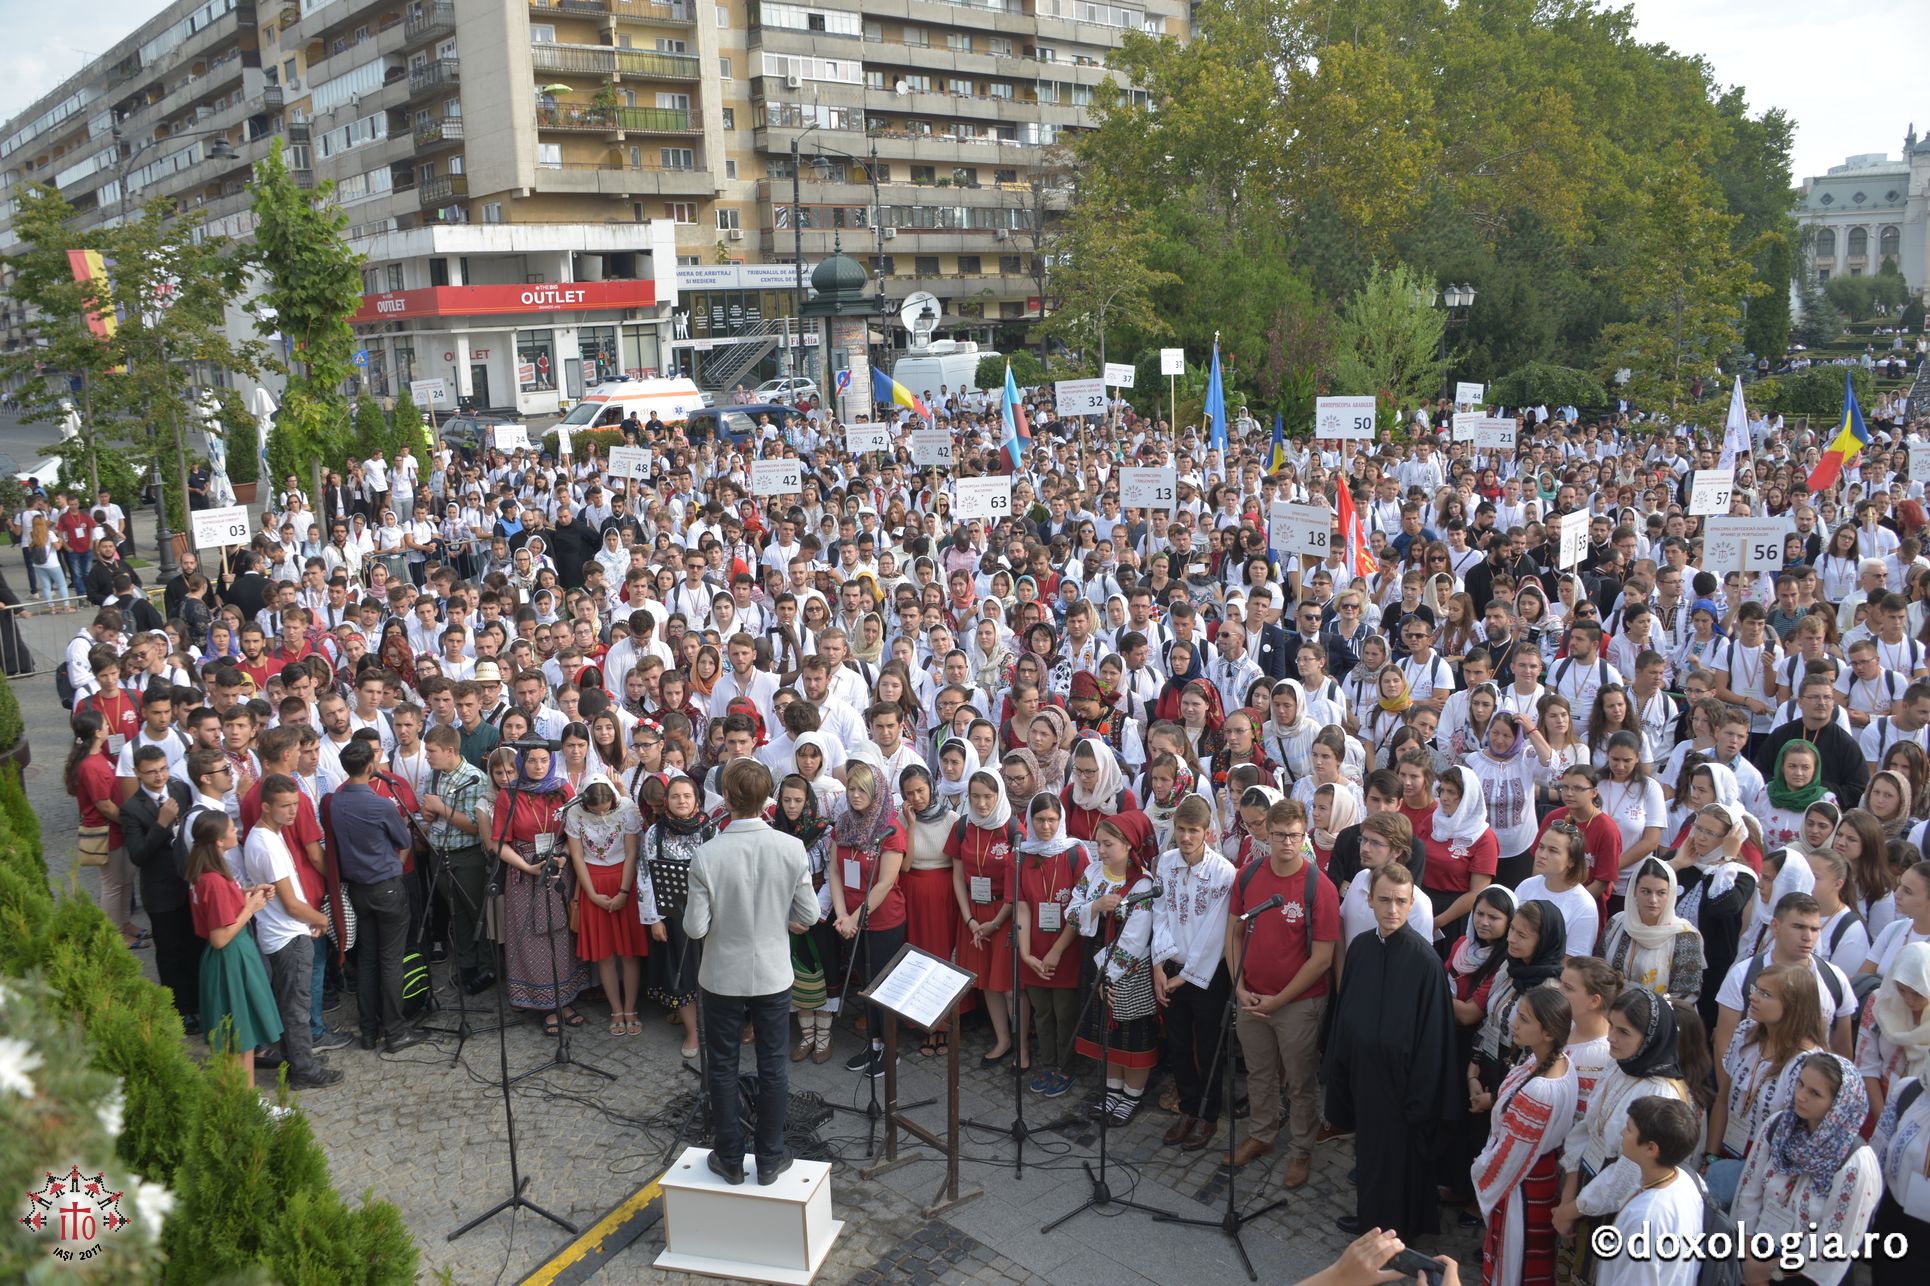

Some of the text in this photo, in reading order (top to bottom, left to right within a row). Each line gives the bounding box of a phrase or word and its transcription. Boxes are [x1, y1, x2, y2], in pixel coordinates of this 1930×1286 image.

[521, 290, 586, 304] OUTLET
[377, 299, 405, 312] OUTLET
[791, 336, 817, 345] Fielia
[444, 349, 490, 361] OLET
[1176, 360, 1183, 368] 37
[433, 390, 443, 398] 24
[1088, 396, 1103, 407] 32
[1354, 417, 1372, 430] 50
[872, 436, 883, 445] 42
[1500, 433, 1512, 442] 21
[938, 446, 949, 457] 42
[635, 463, 648, 473] 48
[783, 475, 797, 486] 42
[1156, 488, 1172, 500] 13
[1716, 492, 1729, 505] 57
[991, 496, 1007, 508] 63
[230, 525, 246, 536] 03
[1308, 531, 1326, 546] 18
[1579, 534, 1586, 551] 55
[1754, 544, 1778, 560] 56
